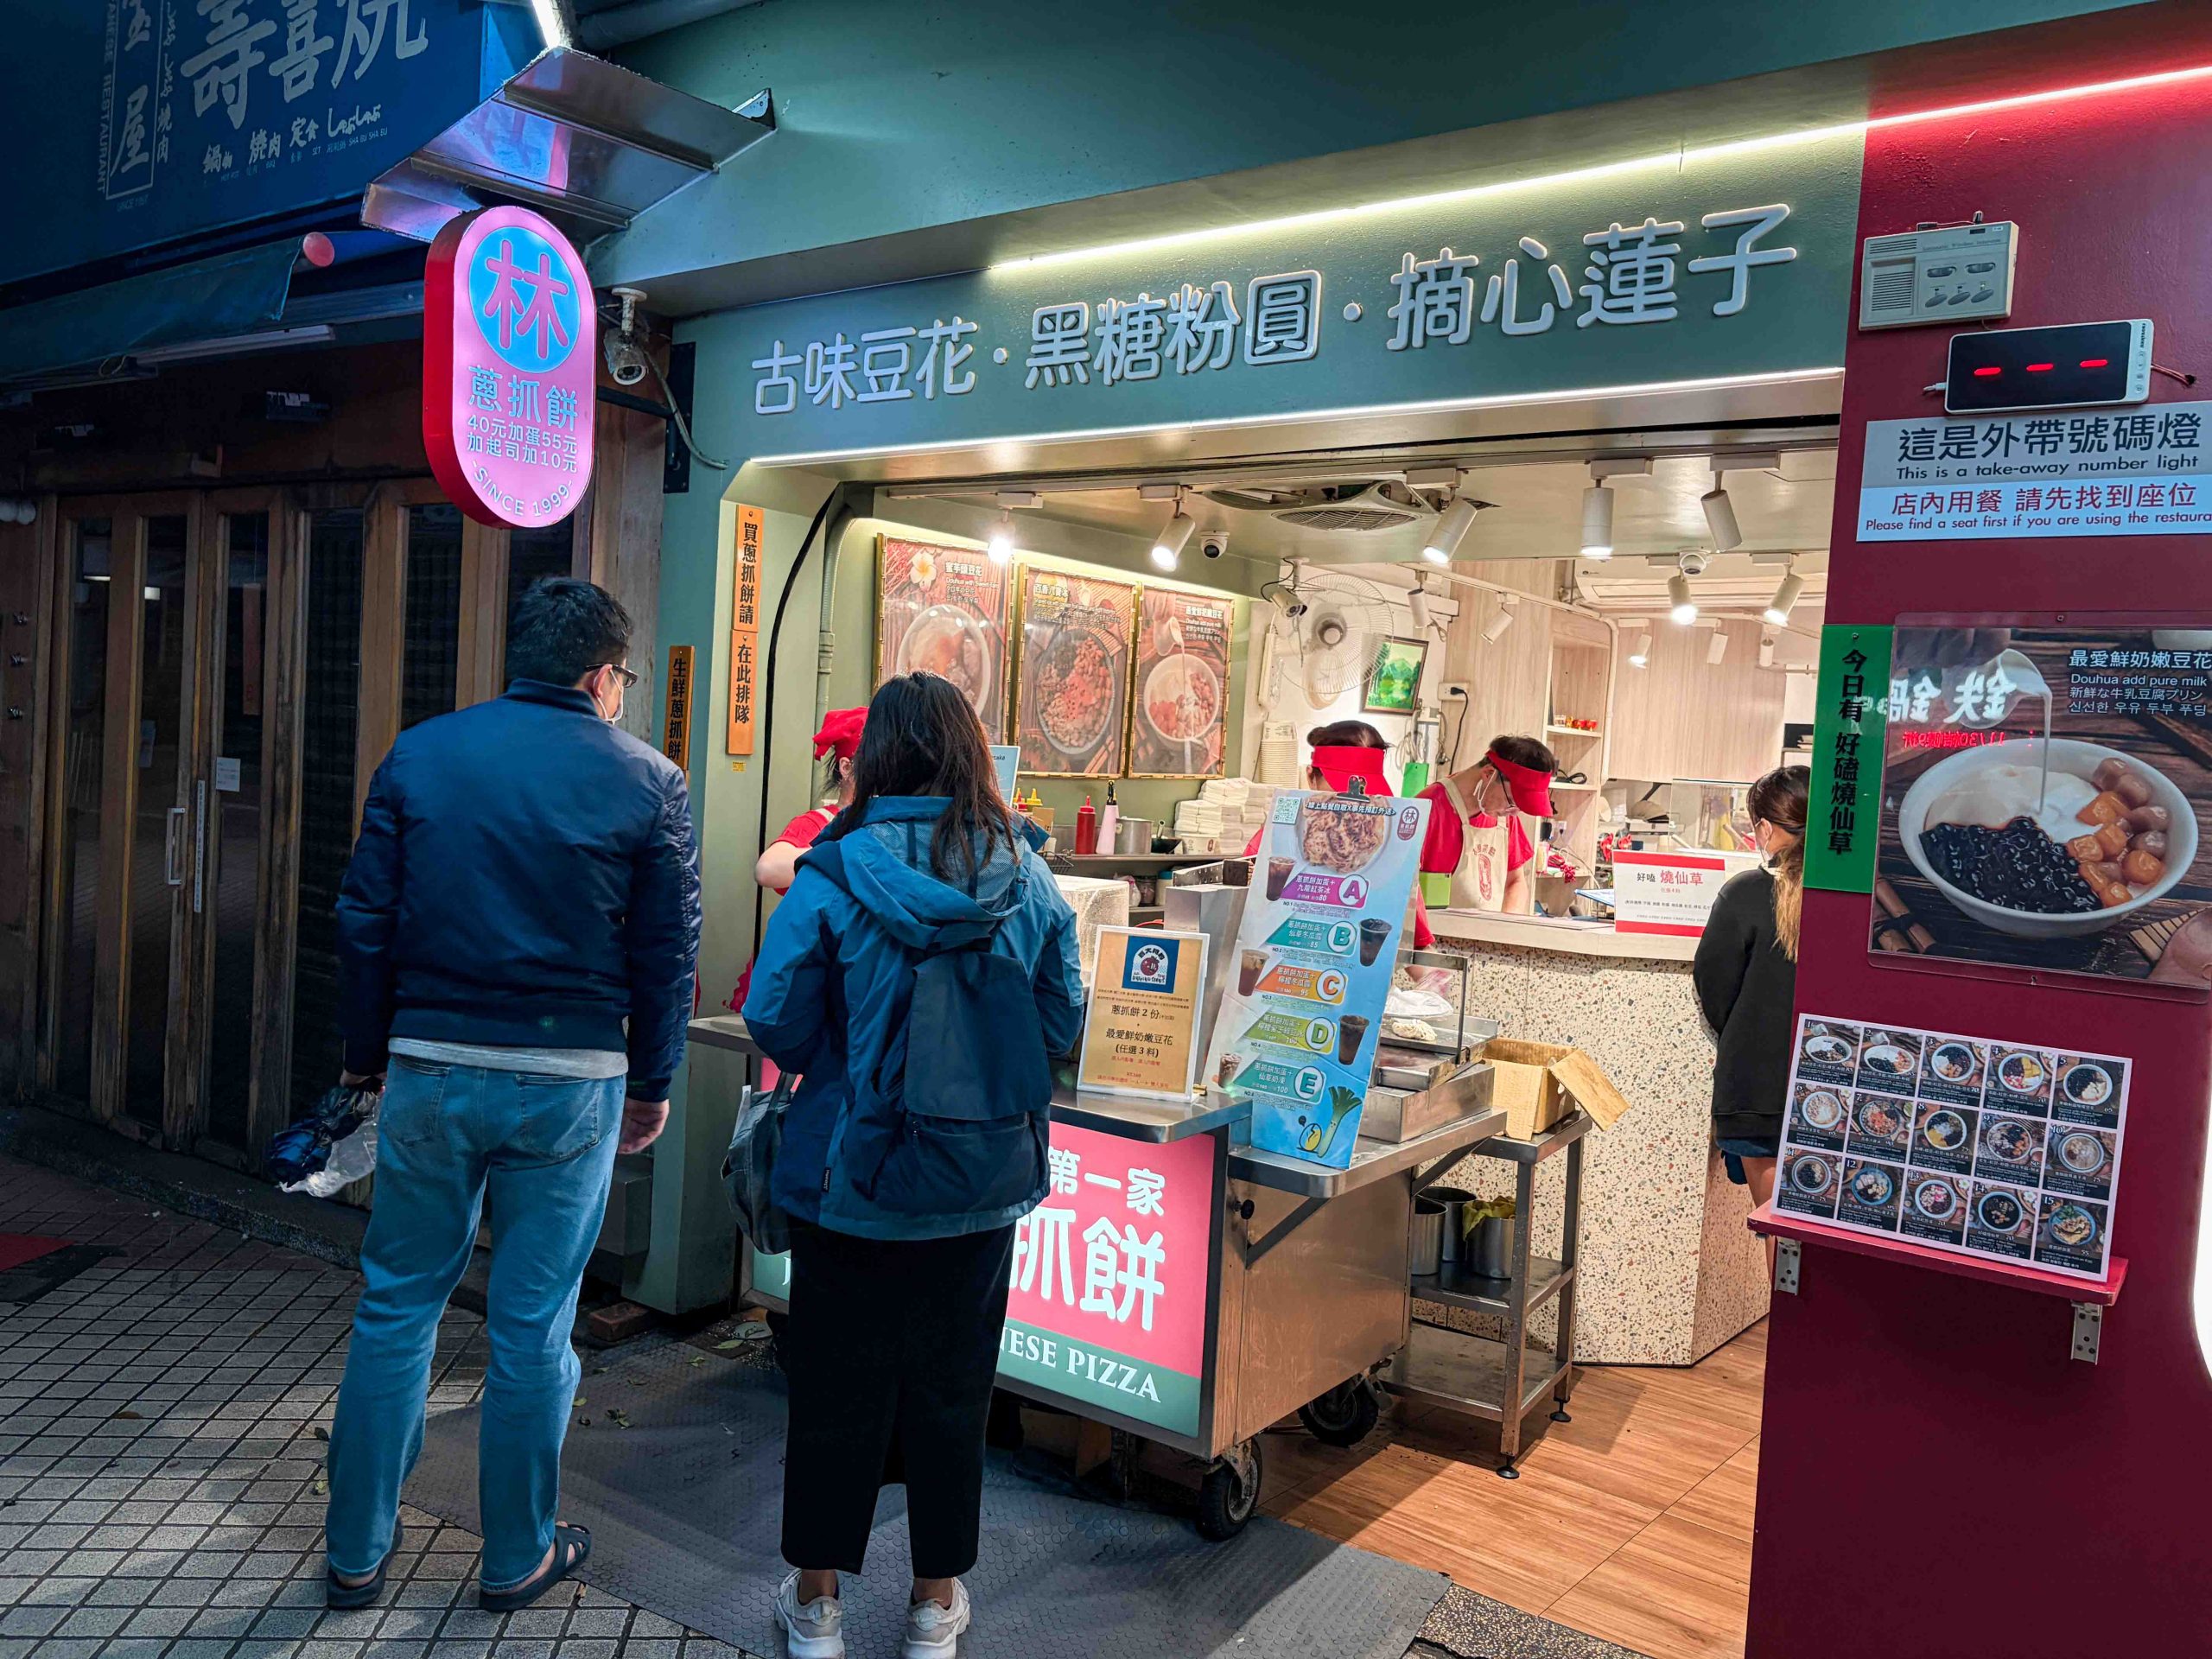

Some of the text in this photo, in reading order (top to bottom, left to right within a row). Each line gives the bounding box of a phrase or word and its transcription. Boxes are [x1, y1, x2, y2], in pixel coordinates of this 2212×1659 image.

[485, 239, 569, 359] 林
[467, 413, 578, 455] 40元加蛋55元
[1897, 412, 2202, 463] 這是外帶號碼燈
[467, 431, 578, 474] 加起司加10元
[1897, 454, 2199, 480] This is a take-away number light
[2015, 481, 2197, 512] 請先找到座位
[1866, 519, 1904, 531] Please
[1908, 518, 1933, 530] find
[1937, 520, 1946, 529] a
[1951, 518, 1977, 529] seat
[1982, 516, 2007, 528] first
[2012, 515, 2022, 526] if
[2027, 517, 2051, 531] you
[2057, 516, 2079, 526] are
[2085, 514, 2121, 529] using
[2127, 512, 2149, 524] the
[2069, 650, 2212, 670] 最愛鮮奶嫩豆花
[734, 644, 753, 725] 在此排隊
[1839, 649, 1866, 722] 今日有
[2071, 674, 2208, 688] Douhua add pure milk
[2069, 687, 2202, 701] 新鮮な牛乳豆腐プリン
[2069, 701, 2207, 716] 신선한 우유 두부 푸딩
[1343, 880, 1361, 899] A
[1333, 925, 1351, 946] B
[1323, 976, 1340, 995] C
[1312, 1023, 1329, 1044] D
[1300, 1072, 1318, 1095] E
[1066, 1347, 1161, 1403] PIZZA
